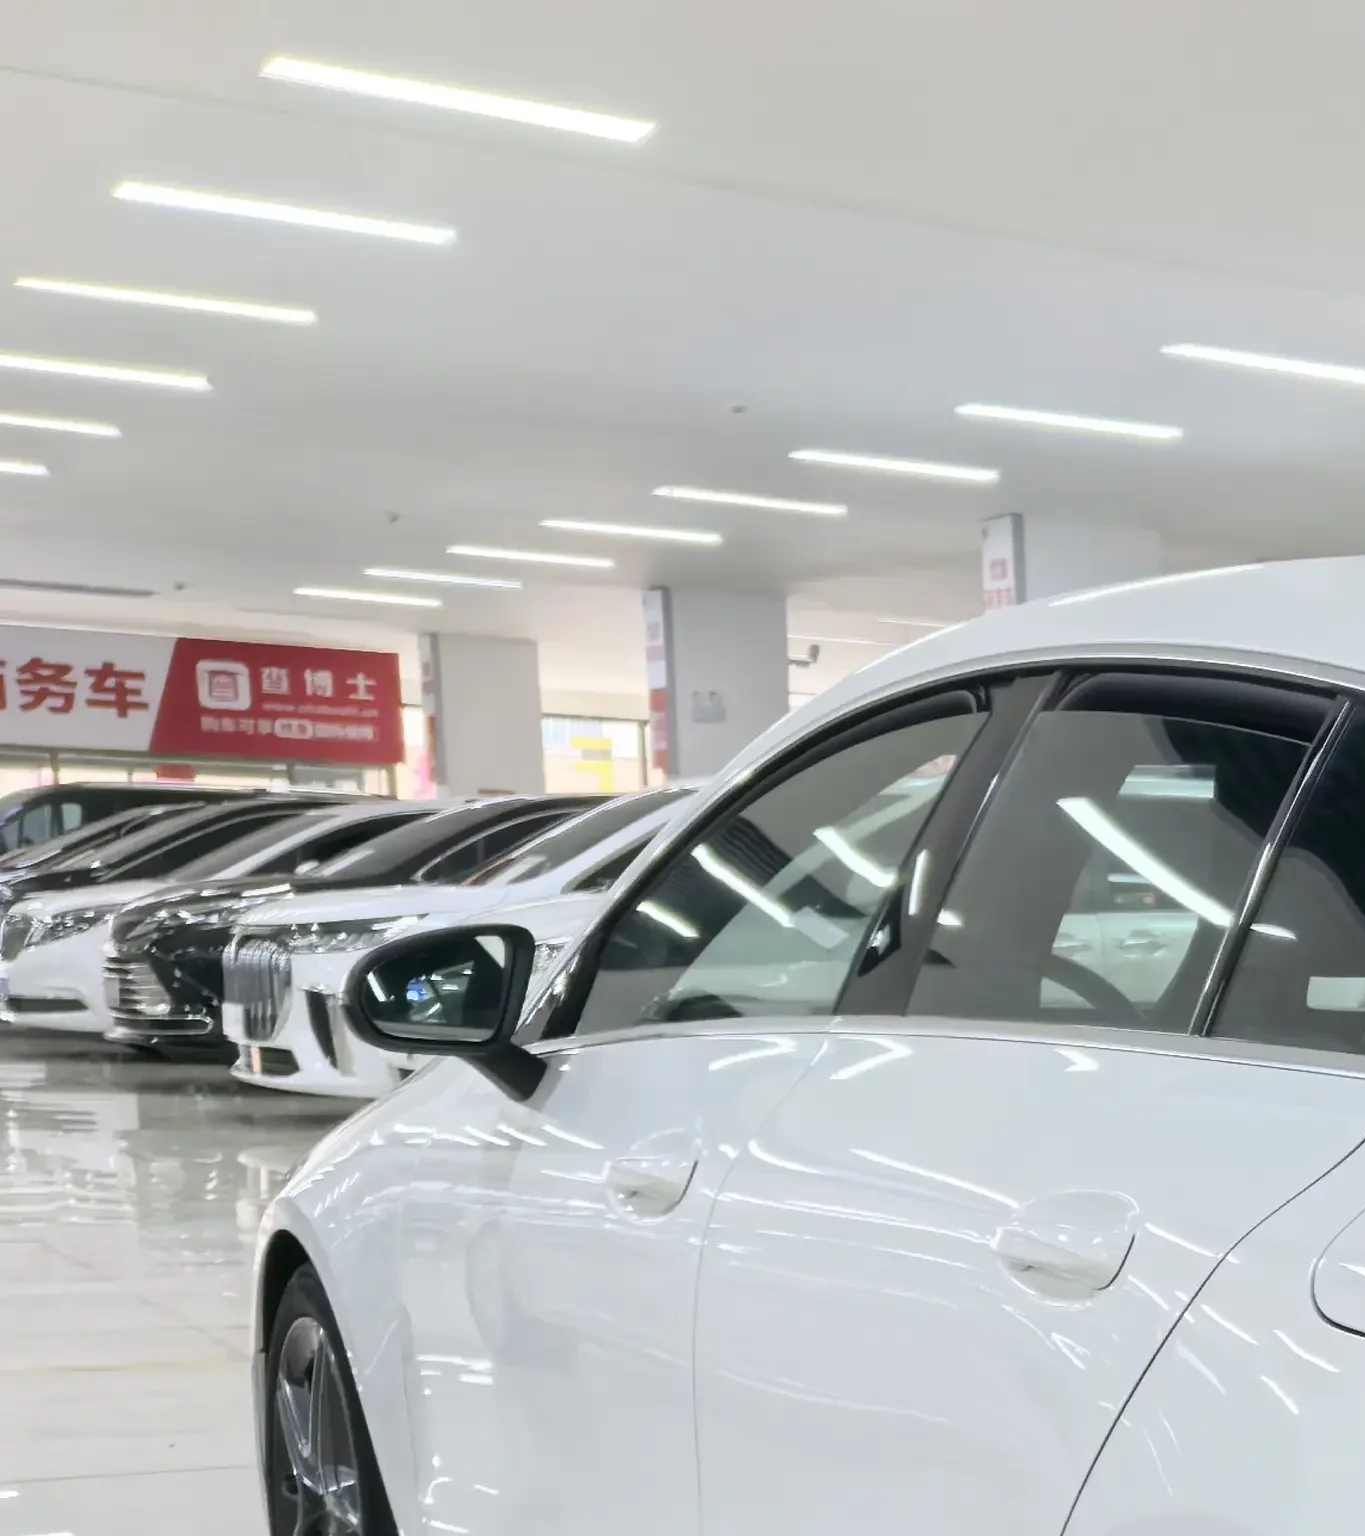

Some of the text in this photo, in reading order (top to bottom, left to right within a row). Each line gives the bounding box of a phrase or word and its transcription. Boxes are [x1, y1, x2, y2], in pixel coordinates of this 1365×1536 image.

[0, 657, 149, 719] 务车
[260, 666, 378, 701] 查博士
